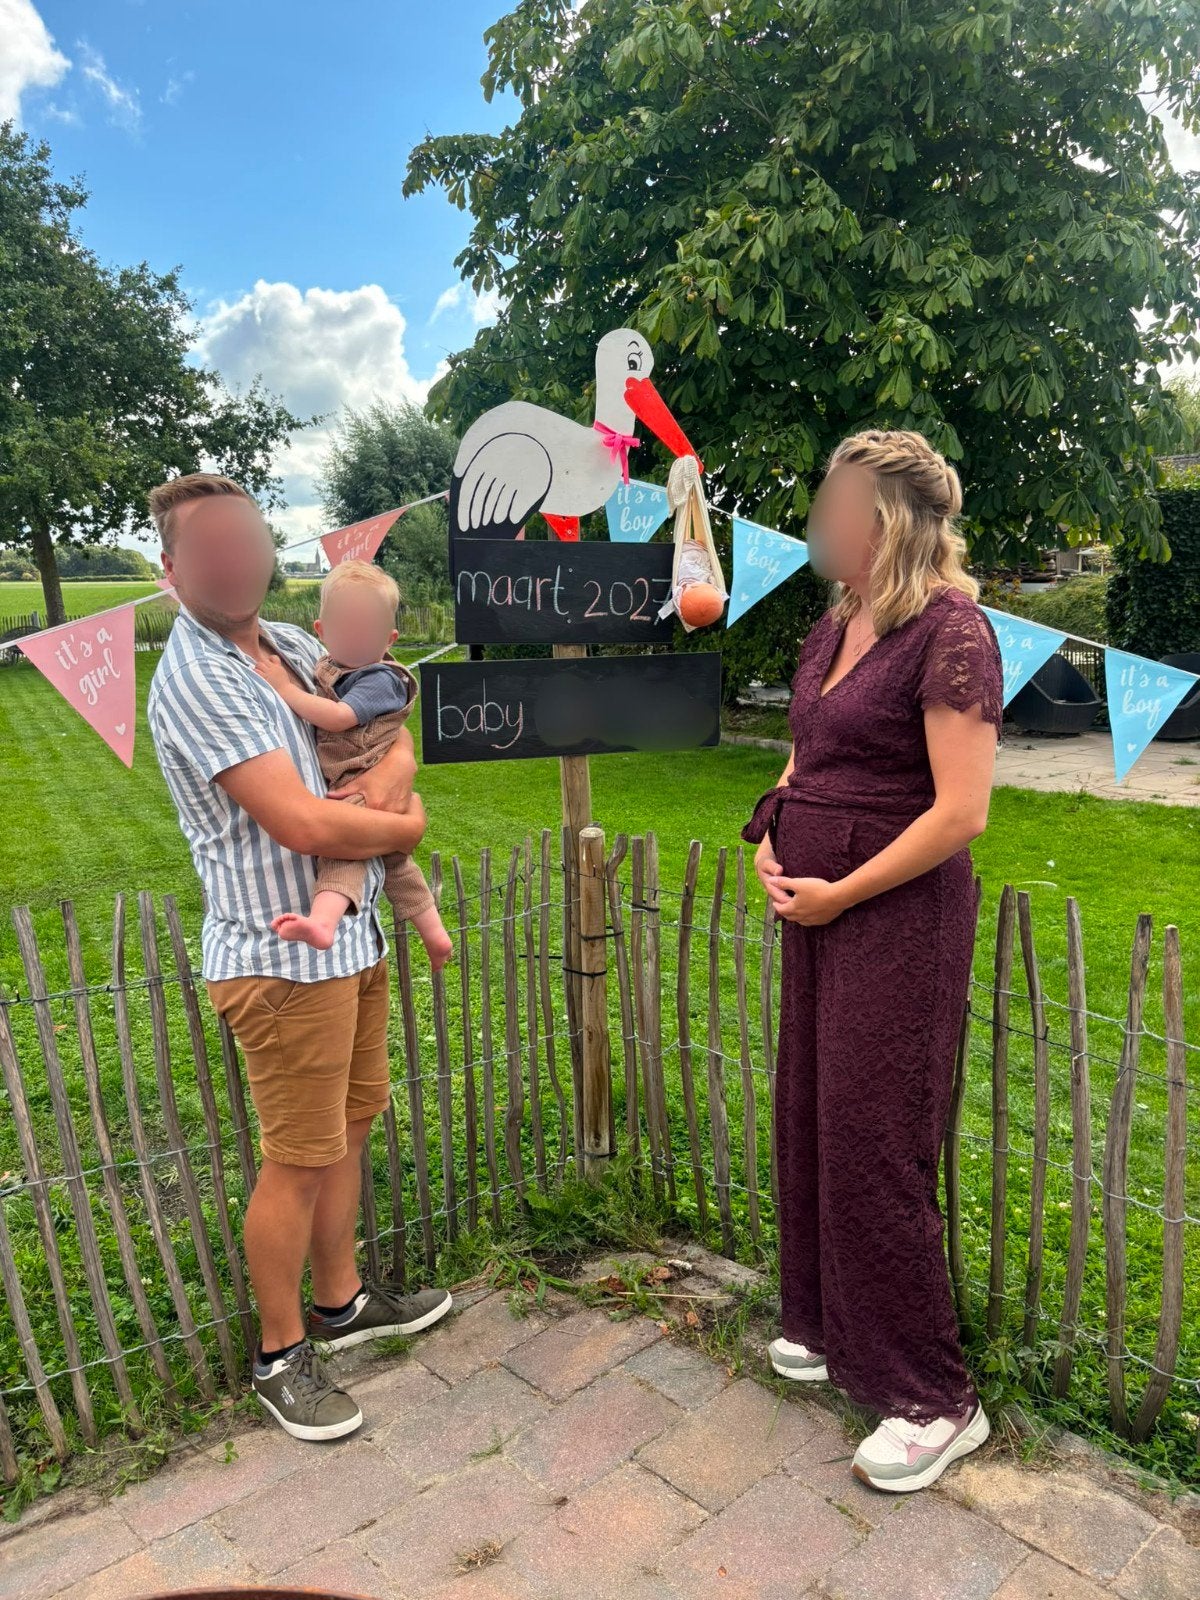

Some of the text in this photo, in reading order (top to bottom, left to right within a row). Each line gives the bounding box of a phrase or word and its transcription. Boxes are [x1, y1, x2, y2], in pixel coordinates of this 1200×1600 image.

[617, 485, 663, 505] it's a
[620, 506, 654, 542] boy
[745, 546, 781, 588] boy
[780, 541, 793, 553] a
[457, 565, 673, 626] maart 2027
[55, 627, 113, 670] it's a
[1021, 637, 1035, 650] a
[79, 647, 121, 706] girl
[1120, 664, 1171, 688] it's a
[436, 674, 524, 749] baby
[1122, 689, 1163, 731] boy
